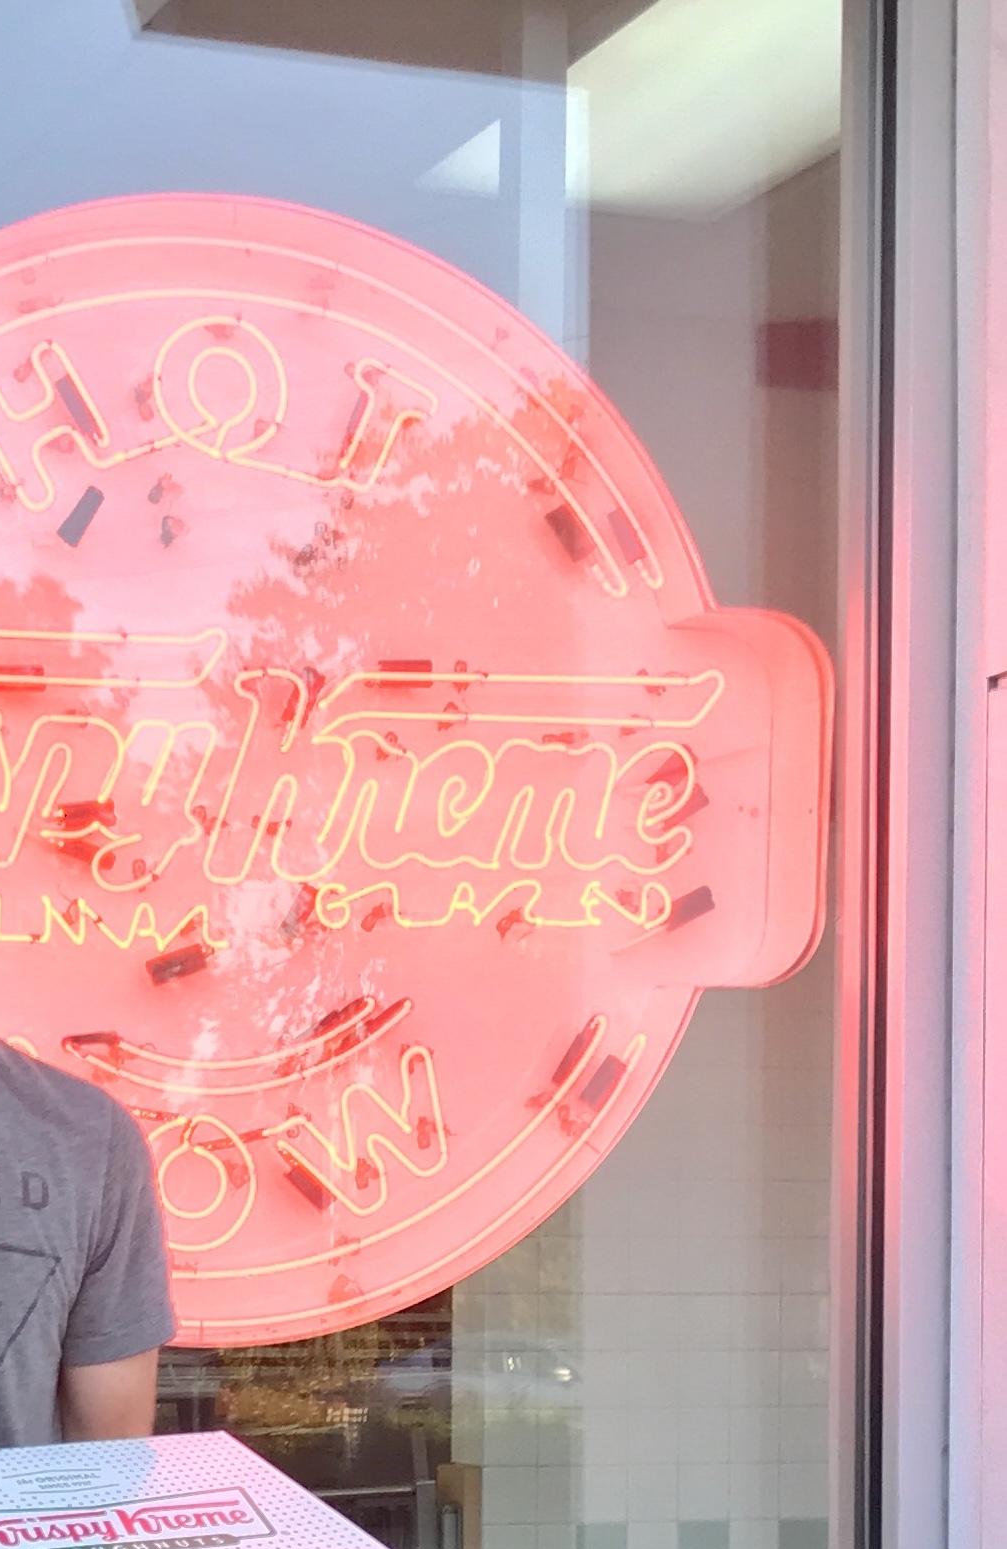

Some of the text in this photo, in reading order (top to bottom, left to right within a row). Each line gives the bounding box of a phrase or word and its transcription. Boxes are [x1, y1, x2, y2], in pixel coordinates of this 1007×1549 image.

[203, 668, 725, 885] Kreme
[11, 1036, 449, 1253] OW
[115, 1500, 254, 1536] Kreme
